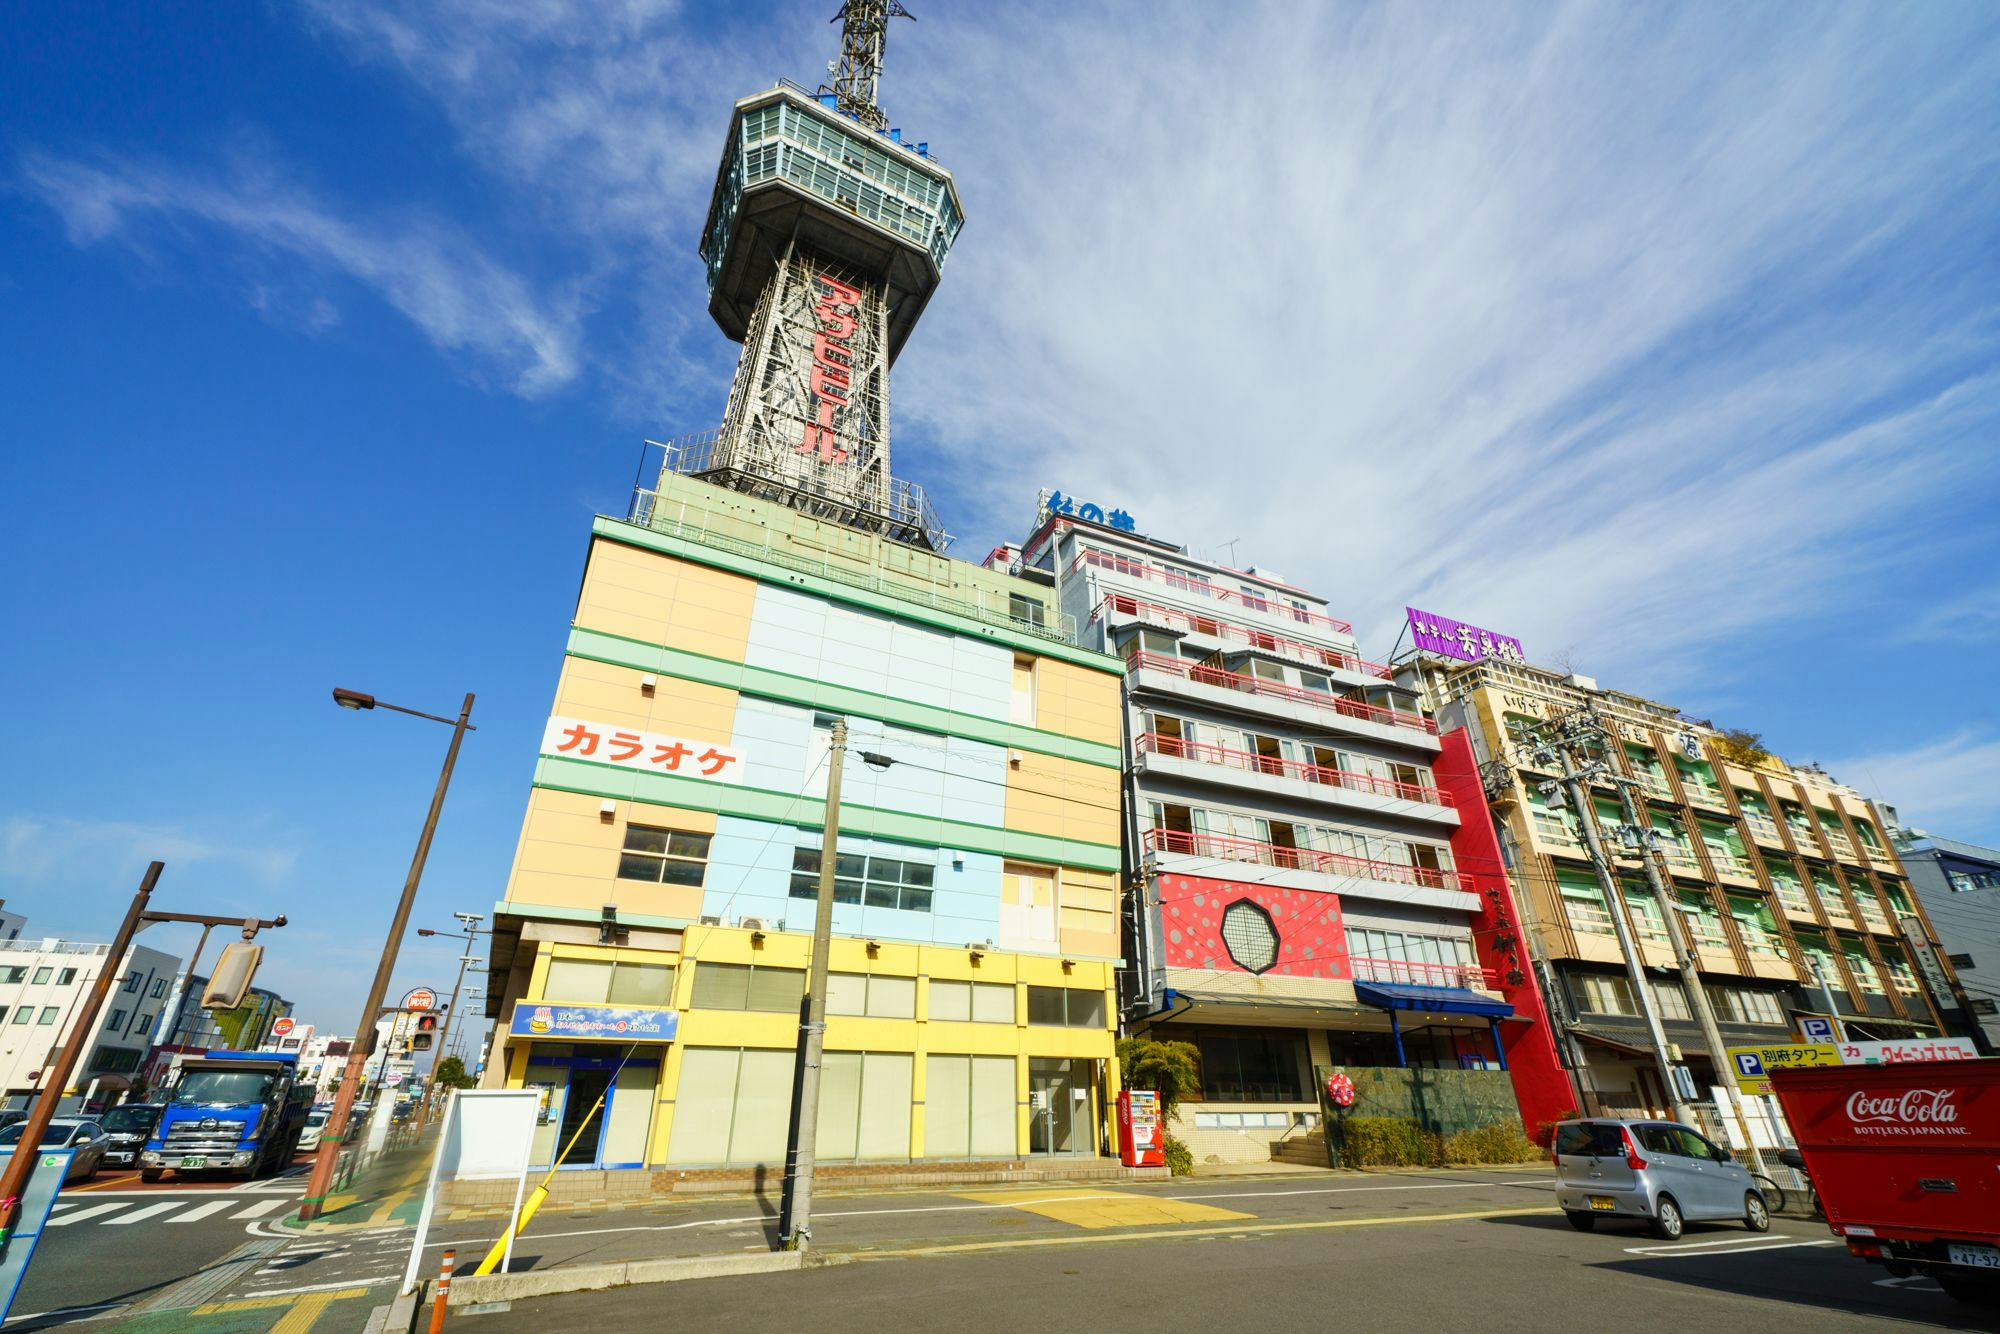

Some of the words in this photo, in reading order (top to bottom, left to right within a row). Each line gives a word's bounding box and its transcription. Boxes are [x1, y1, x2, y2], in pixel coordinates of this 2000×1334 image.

[795, 274, 862, 465] アサヒビール
[556, 724, 737, 776] カラオケ
[1761, 1049, 1834, 1062] 別府タワー
[1846, 1089, 1958, 1123] Coca-Cola
[1853, 1126, 1909, 1136] BOTTLERS
[1910, 1126, 1946, 1136] JAPAN
[1947, 1126, 1972, 1135] INC.
